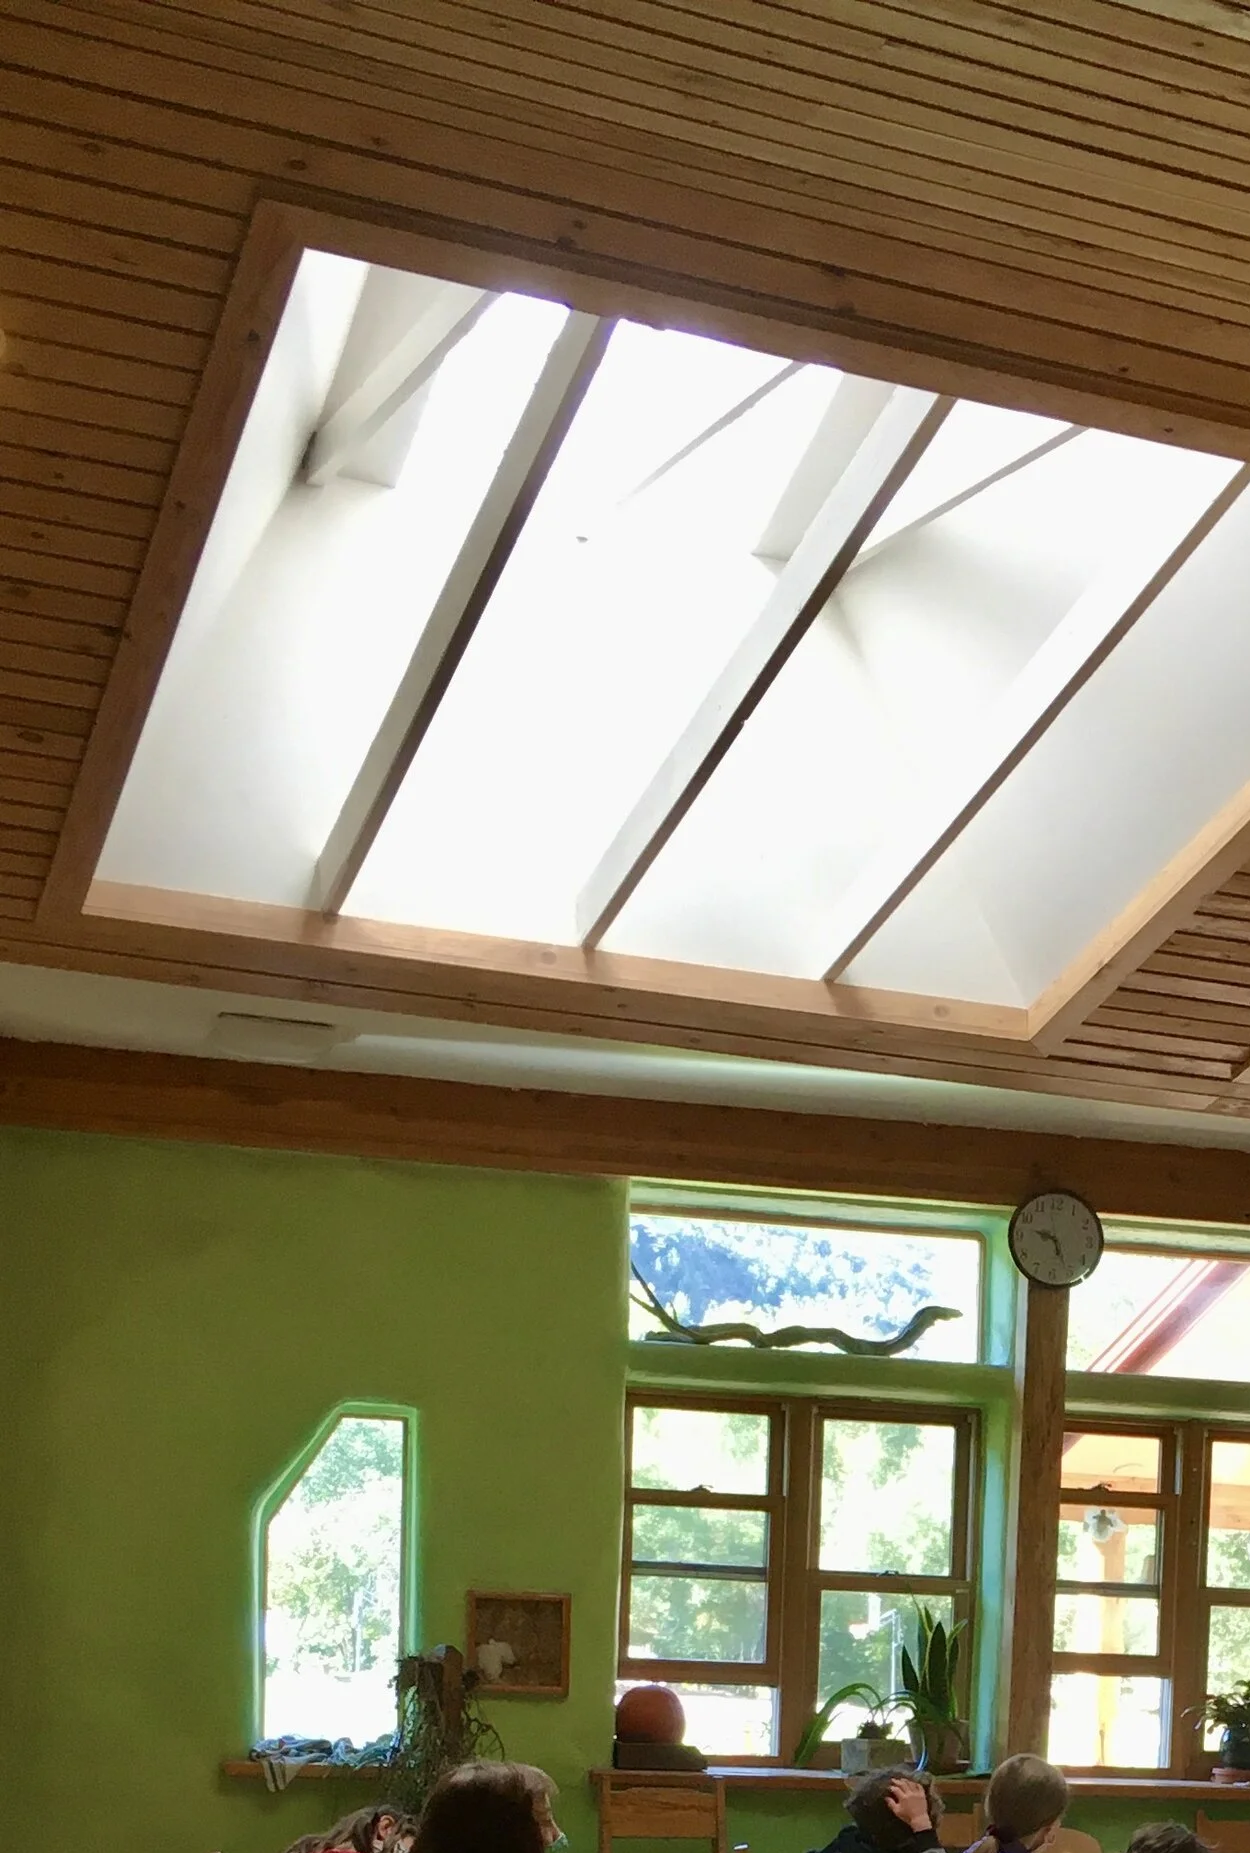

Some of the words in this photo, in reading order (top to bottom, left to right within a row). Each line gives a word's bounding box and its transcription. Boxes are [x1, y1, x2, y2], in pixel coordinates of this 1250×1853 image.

[1035, 1201, 1045, 1213] 11
[1021, 1212, 1033, 1224] 10
[1081, 1218, 1090, 1230] 2
[1016, 1230, 1024, 1242] 9
[1085, 1236, 1094, 1249] 3
[1020, 1248, 1029, 1261] 8
[1079, 1254, 1086, 1266] 4
[1032, 1262, 1041, 1275] 7
